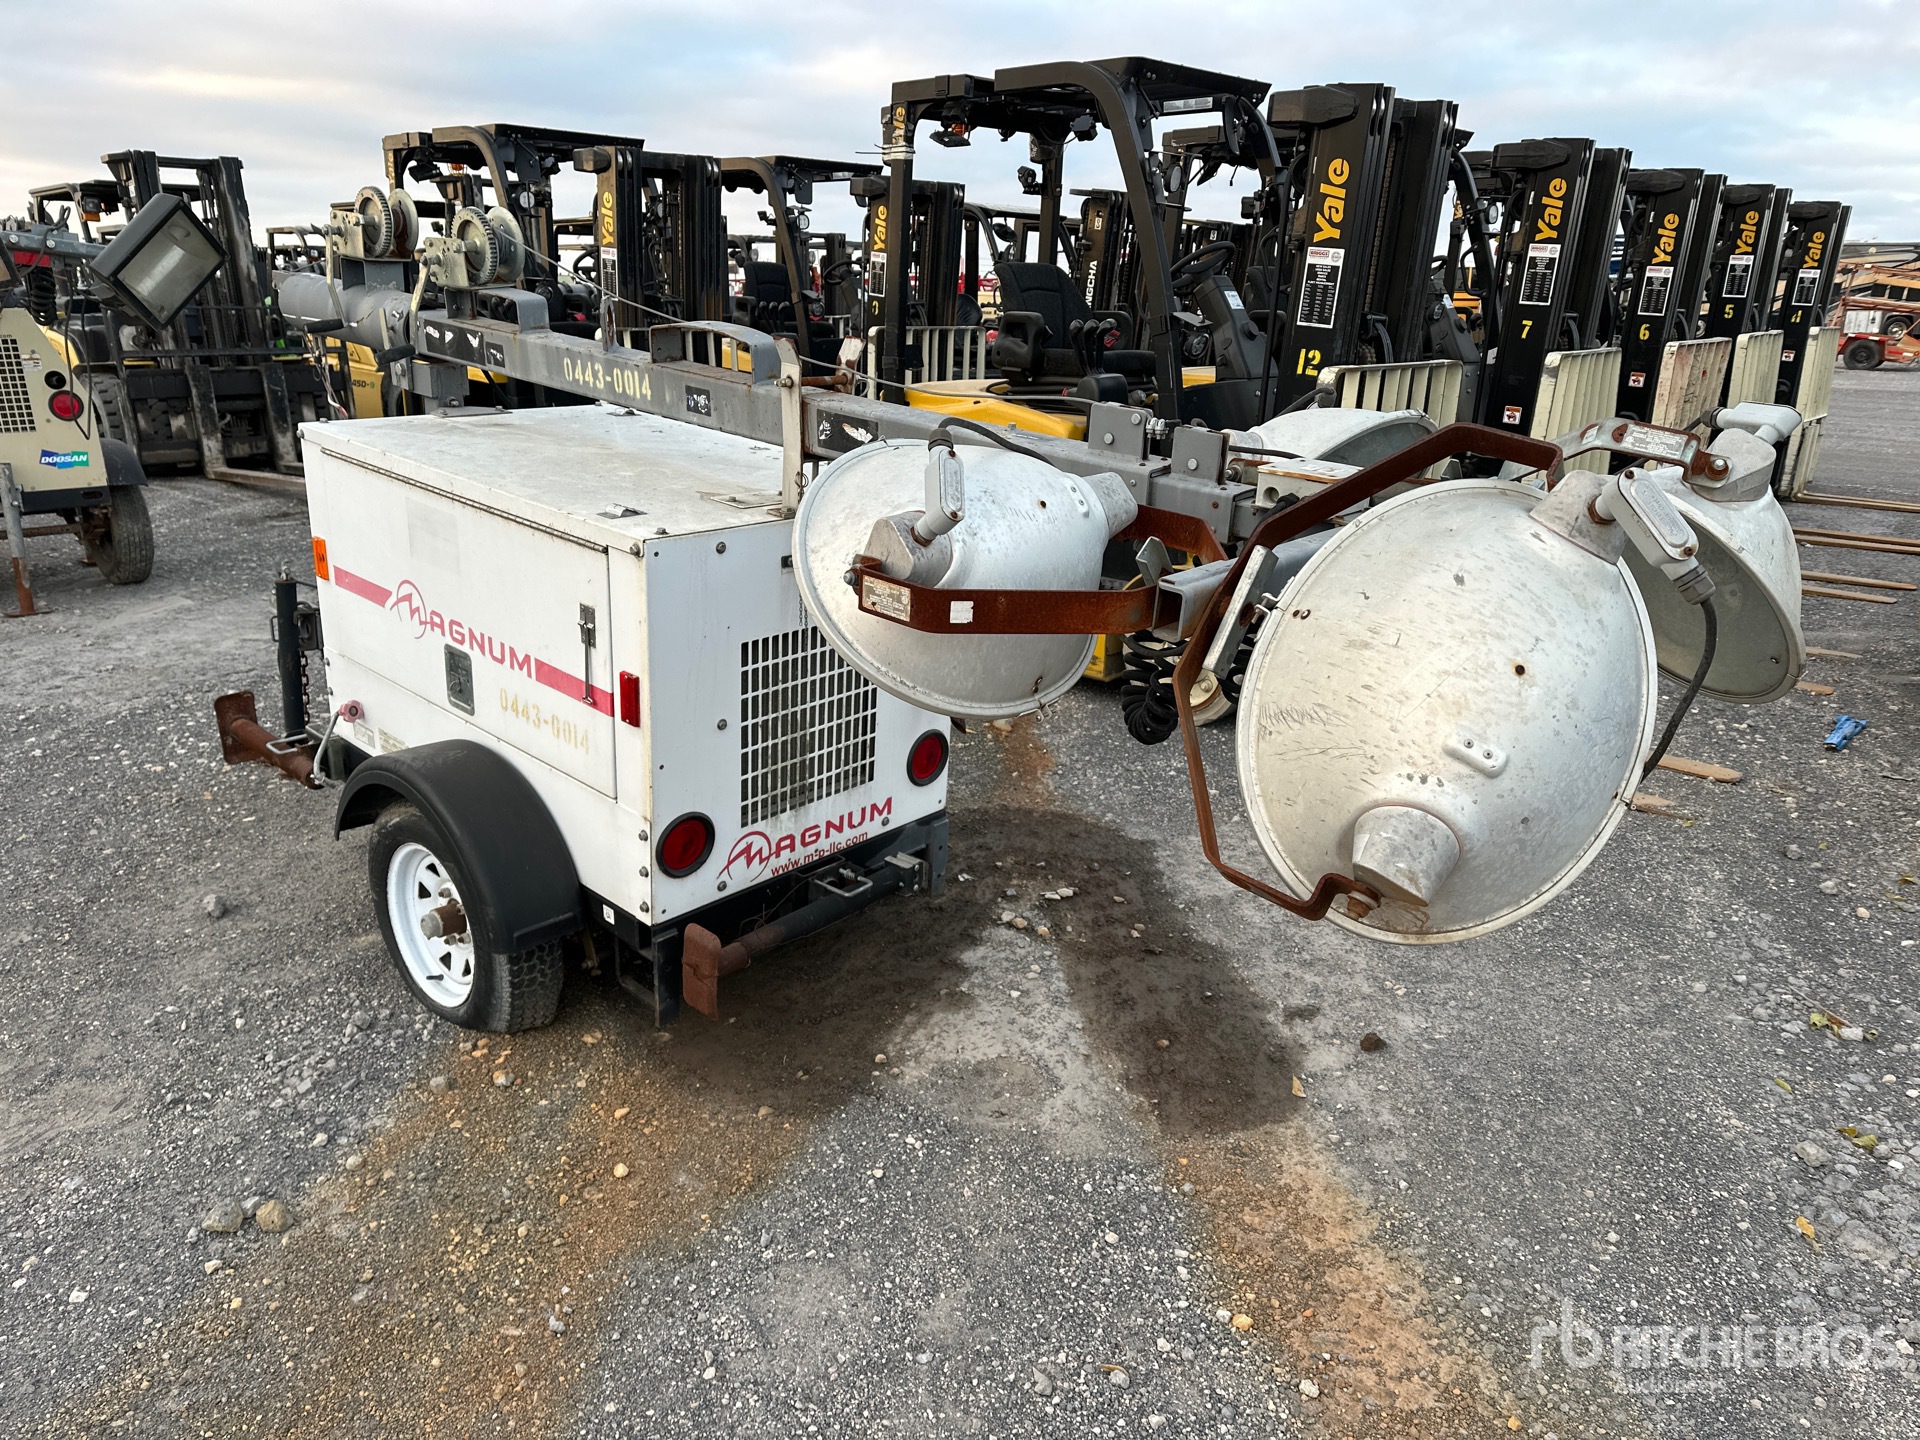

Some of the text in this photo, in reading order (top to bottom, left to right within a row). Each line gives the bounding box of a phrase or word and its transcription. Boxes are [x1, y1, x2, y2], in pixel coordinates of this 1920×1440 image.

[601, 191, 614, 246] Yale
[1313, 158, 1350, 243] Yale
[1535, 178, 1567, 242] Yale
[874, 205, 888, 250] Yale
[1652, 213, 1680, 264] Yale
[1735, 210, 1759, 254] Yale
[1803, 231, 1825, 268] Yale
[1085, 260, 1098, 308] NGCHA
[1521, 320, 1533, 339] 7
[1639, 324, 1650, 340] 6
[1724, 304, 1734, 319] 5
[563, 357, 651, 401] 0443-0014
[1296, 349, 1321, 376] 12
[41, 454, 88, 464] DOOSAN
[390, 580, 532, 679] MAGNUM
[500, 687, 590, 755] 0443-0014
[717, 797, 893, 882] MAGNUM
